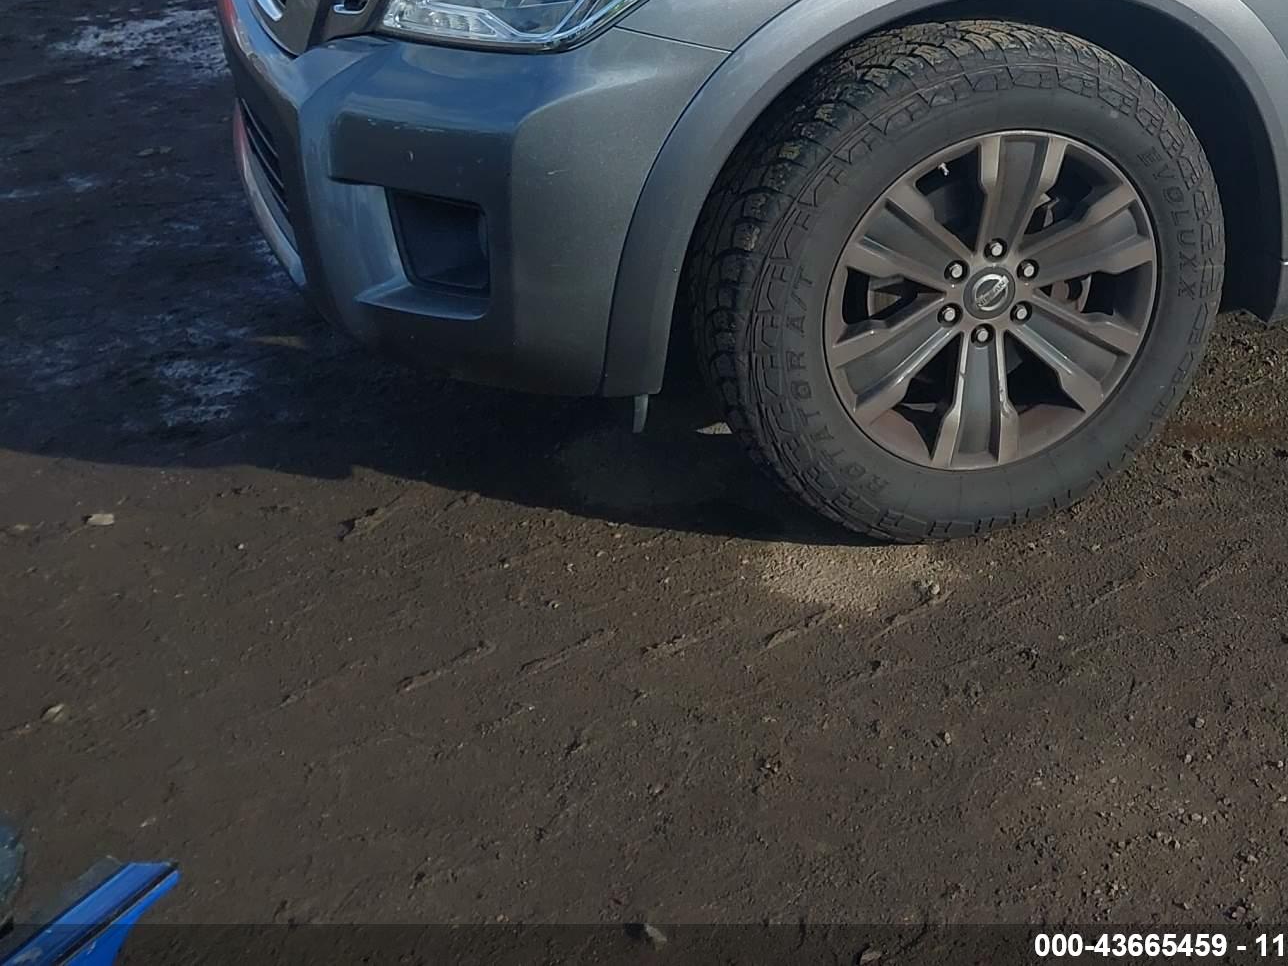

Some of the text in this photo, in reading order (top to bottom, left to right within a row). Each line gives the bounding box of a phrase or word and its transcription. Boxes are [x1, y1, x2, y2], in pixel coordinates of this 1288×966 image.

[1136, 146, 1198, 301] EVOLUXX
[786, 265, 892, 497] ROTATOR A/T
